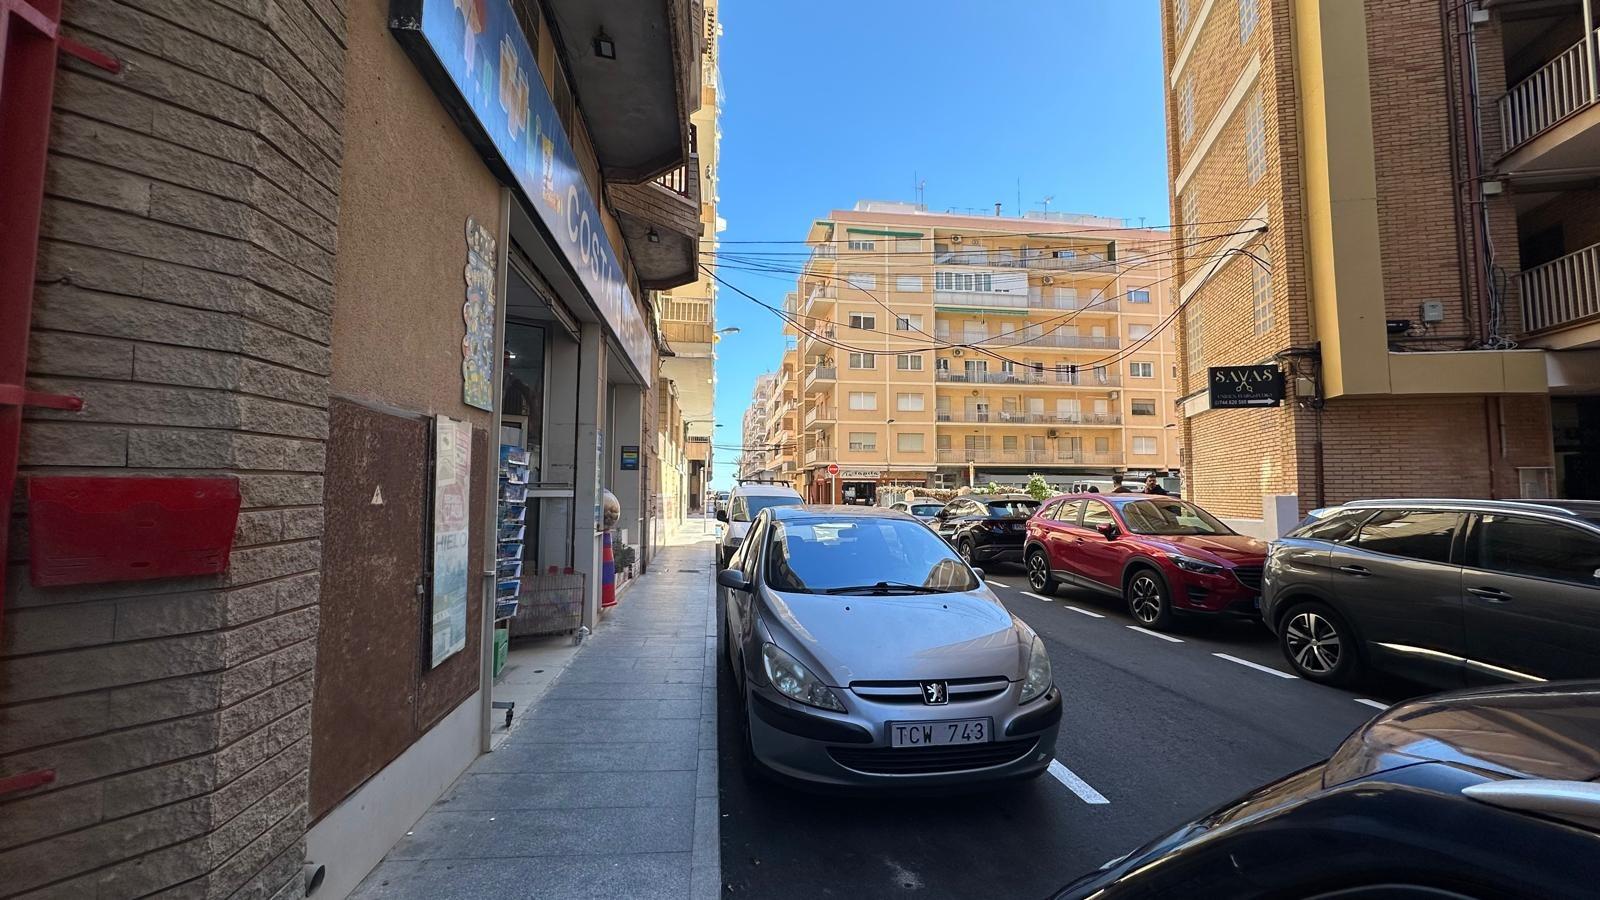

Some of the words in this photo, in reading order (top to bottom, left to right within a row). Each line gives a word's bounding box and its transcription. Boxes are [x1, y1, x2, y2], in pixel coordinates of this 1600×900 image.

[567, 184, 613, 311] COSTA
[1216, 369, 1272, 383] SAVAS
[436, 533, 467, 553] HIELO
[896, 726, 933, 745] TCW
[948, 722, 984, 742] 743
